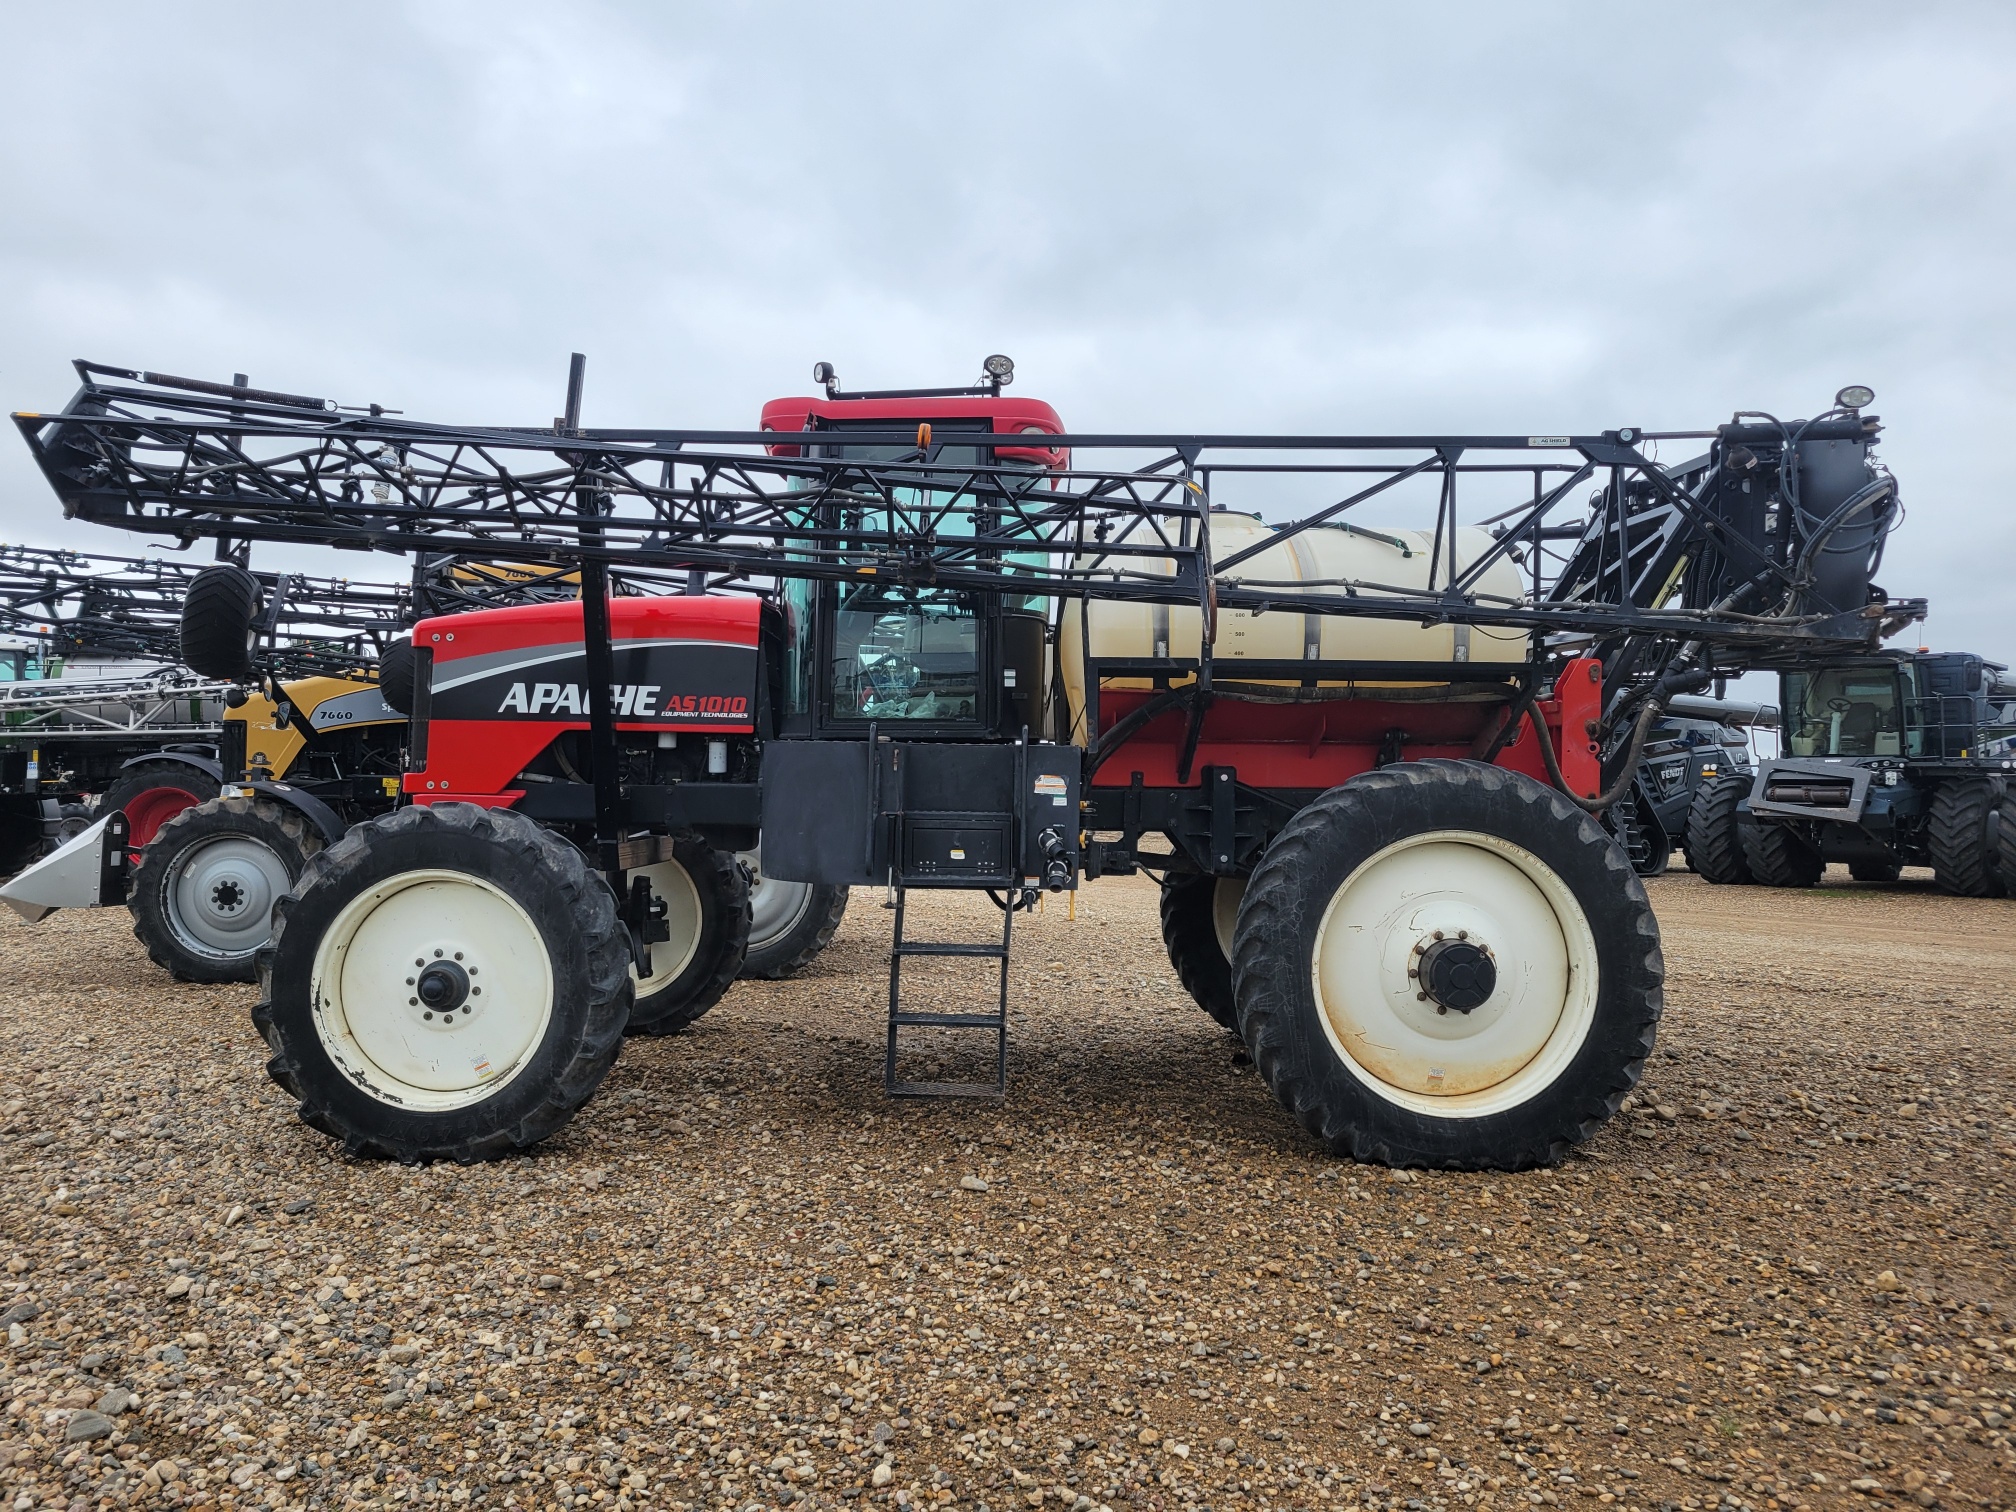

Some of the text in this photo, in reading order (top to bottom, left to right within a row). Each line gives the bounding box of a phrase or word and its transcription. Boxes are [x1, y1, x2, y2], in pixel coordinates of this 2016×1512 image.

[498, 683, 661, 716] APAHE
[665, 695, 748, 712] AS1010
[320, 711, 353, 719] 7660
[1661, 767, 1685, 780] FENDT
